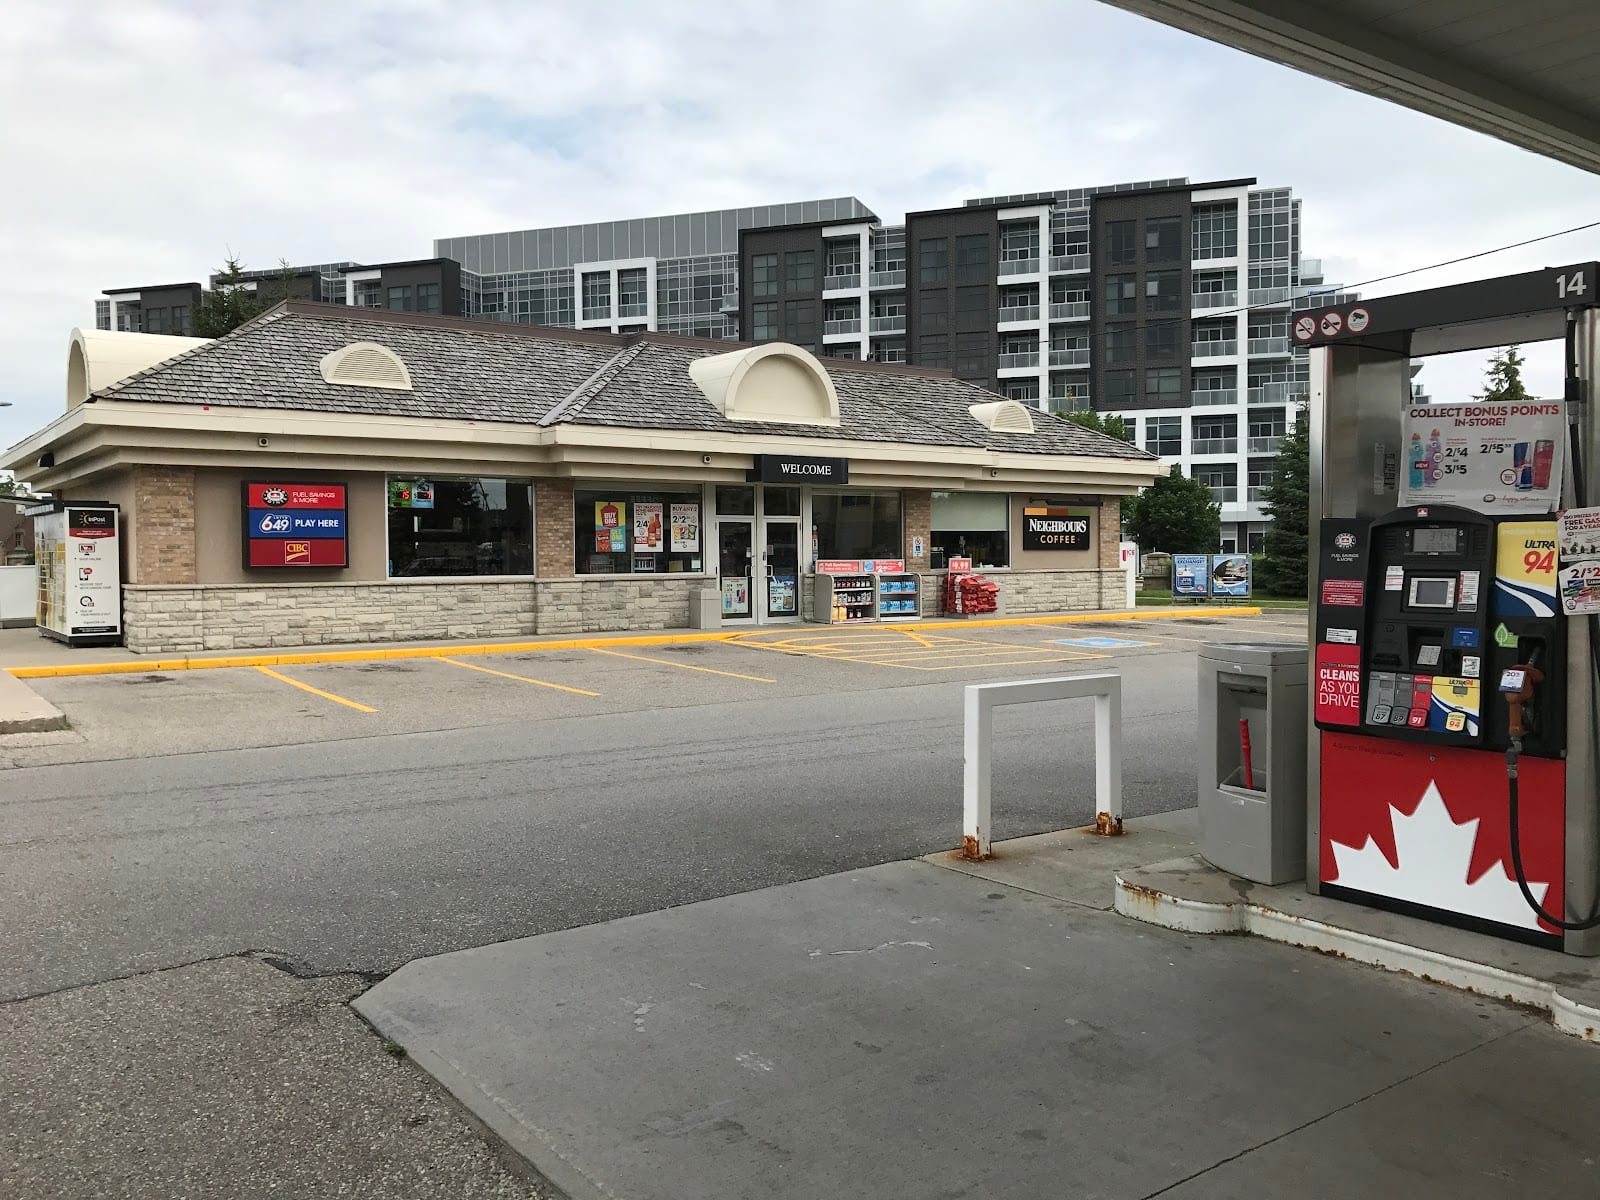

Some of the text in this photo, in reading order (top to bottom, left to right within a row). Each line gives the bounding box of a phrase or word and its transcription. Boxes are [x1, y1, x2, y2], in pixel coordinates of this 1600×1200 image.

[1556, 271, 1587, 299] 14
[1410, 404, 1560, 418] COLLECT BONUS POINTS
[1454, 417, 1507, 427] IN-STORE!
[781, 463, 832, 475] WELCOME
[295, 519, 339, 528] PLAY HERE
[1028, 518, 1087, 533] NEIGHBOURS
[1040, 535, 1076, 544] COFFEE
[1524, 539, 1555, 550] ULTRA
[286, 543, 309, 553] CIBC
[1523, 550, 1555, 575] 94
[1320, 669, 1360, 682] CLEANS
[1320, 680, 1360, 695] AS YOU
[1319, 692, 1360, 708] DRIVE
[1412, 716, 1421, 724] 91
